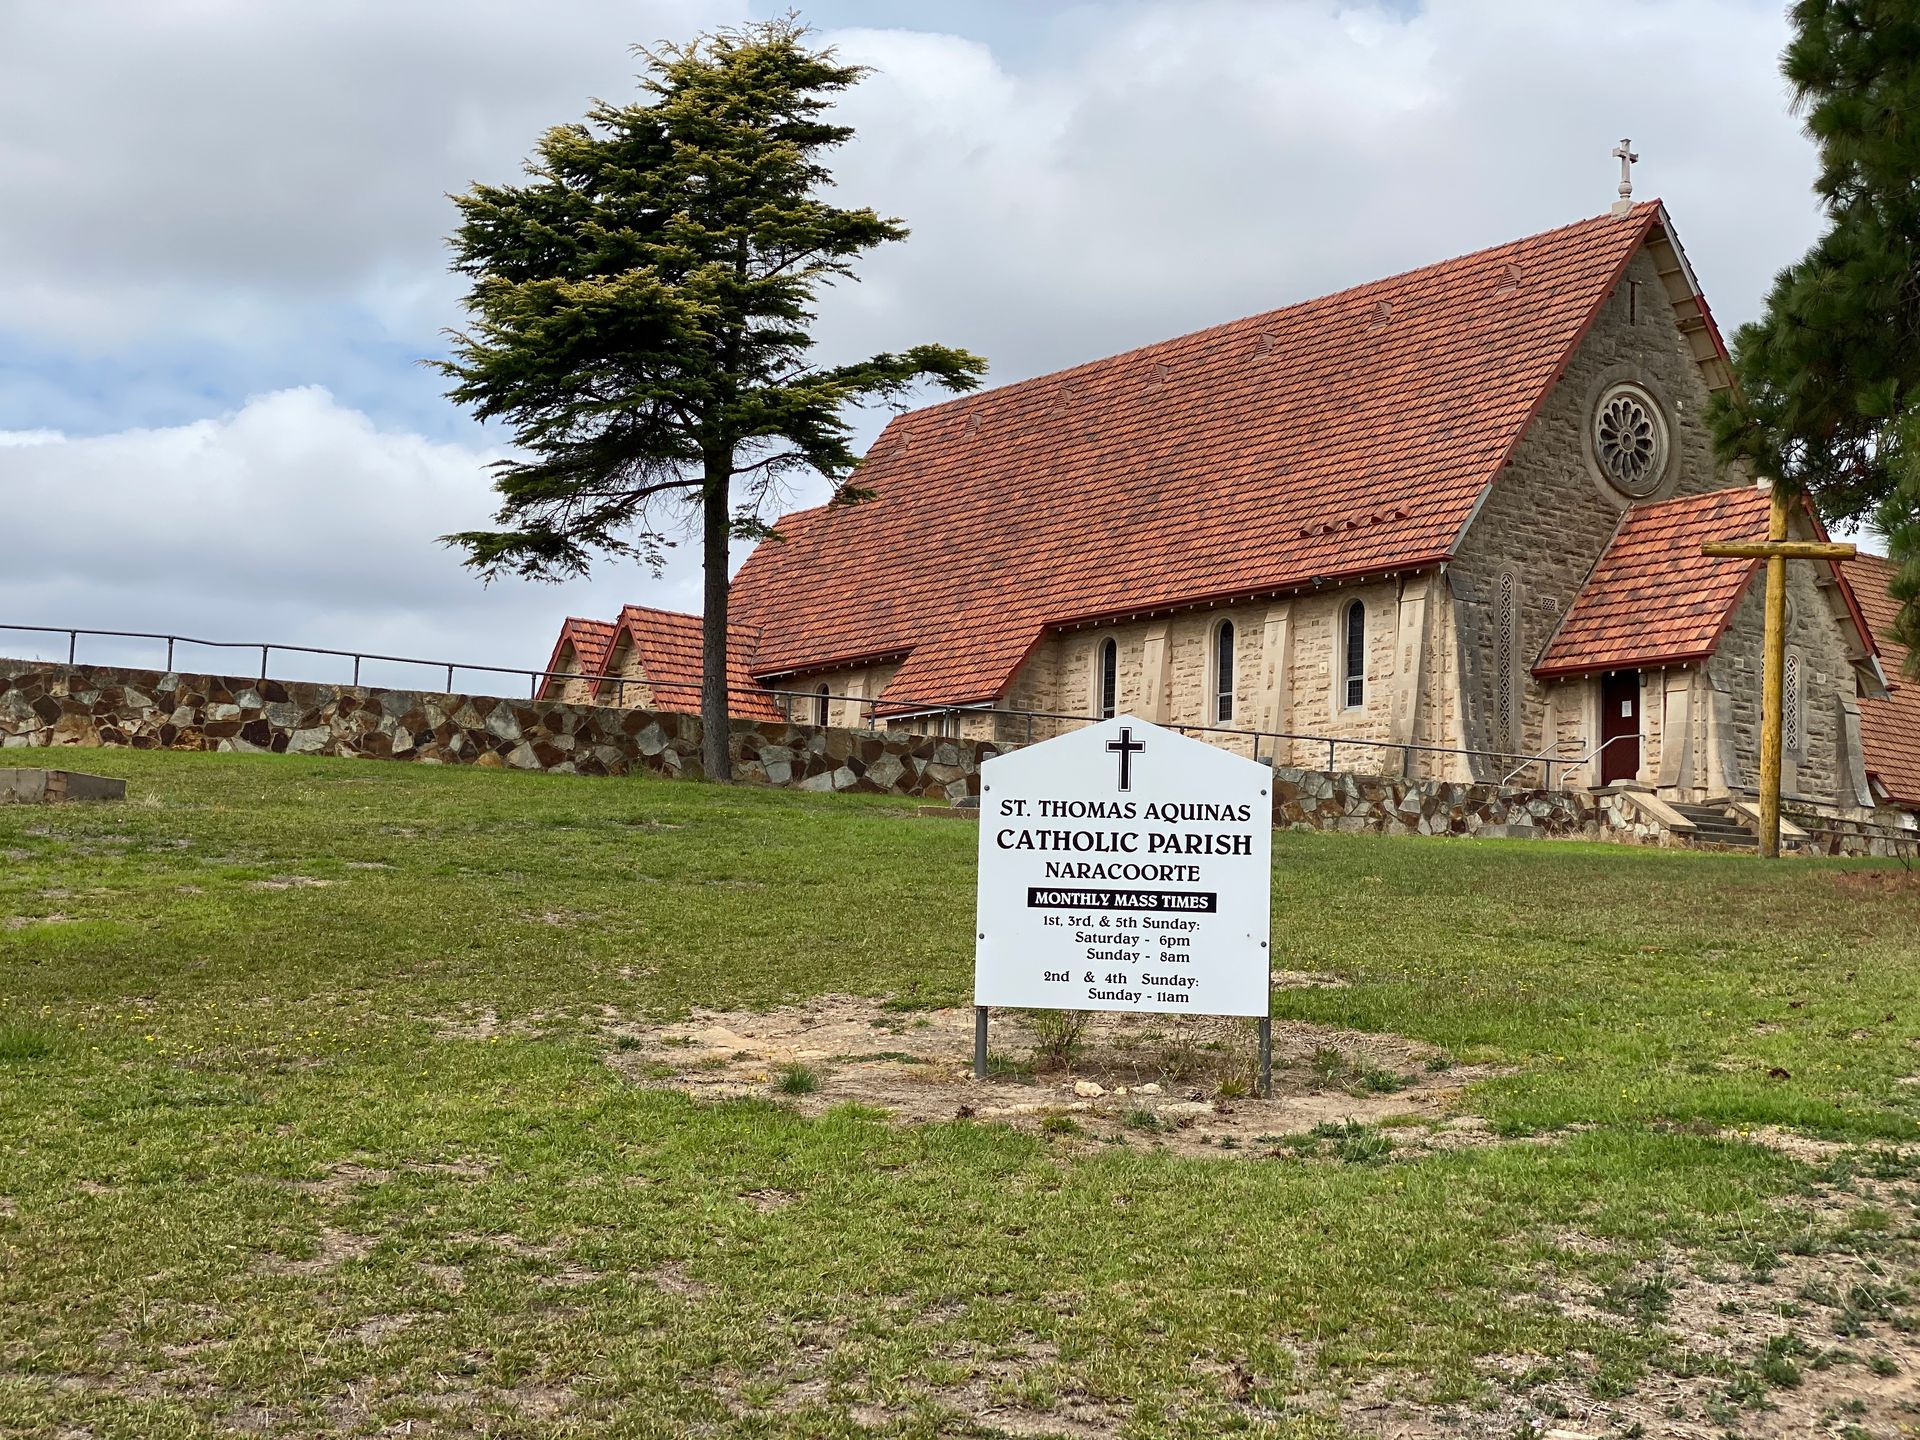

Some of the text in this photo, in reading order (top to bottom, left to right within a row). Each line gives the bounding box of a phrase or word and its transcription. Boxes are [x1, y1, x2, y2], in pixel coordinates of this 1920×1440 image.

[1000, 800, 1250, 823] ST. THOMAS AQUINAS
[997, 829, 1252, 855] CATHOLIC PARISH
[1045, 862, 1200, 881] NARACOORTE
[1034, 892, 1208, 908] MONTHLY MASS TIMES
[1043, 915, 1200, 933] 1st, 3rd, & 5th Sunday:
[1074, 930, 1140, 948] Saturday
[1159, 934, 1191, 949] 6pm
[1086, 947, 1141, 964] Sunday
[1159, 951, 1190, 963] 8am
[1043, 970, 1199, 989] 2nd & 4th Sunday:
[1087, 987, 1142, 1004] Sunday
[1157, 991, 1190, 1003] 11am
